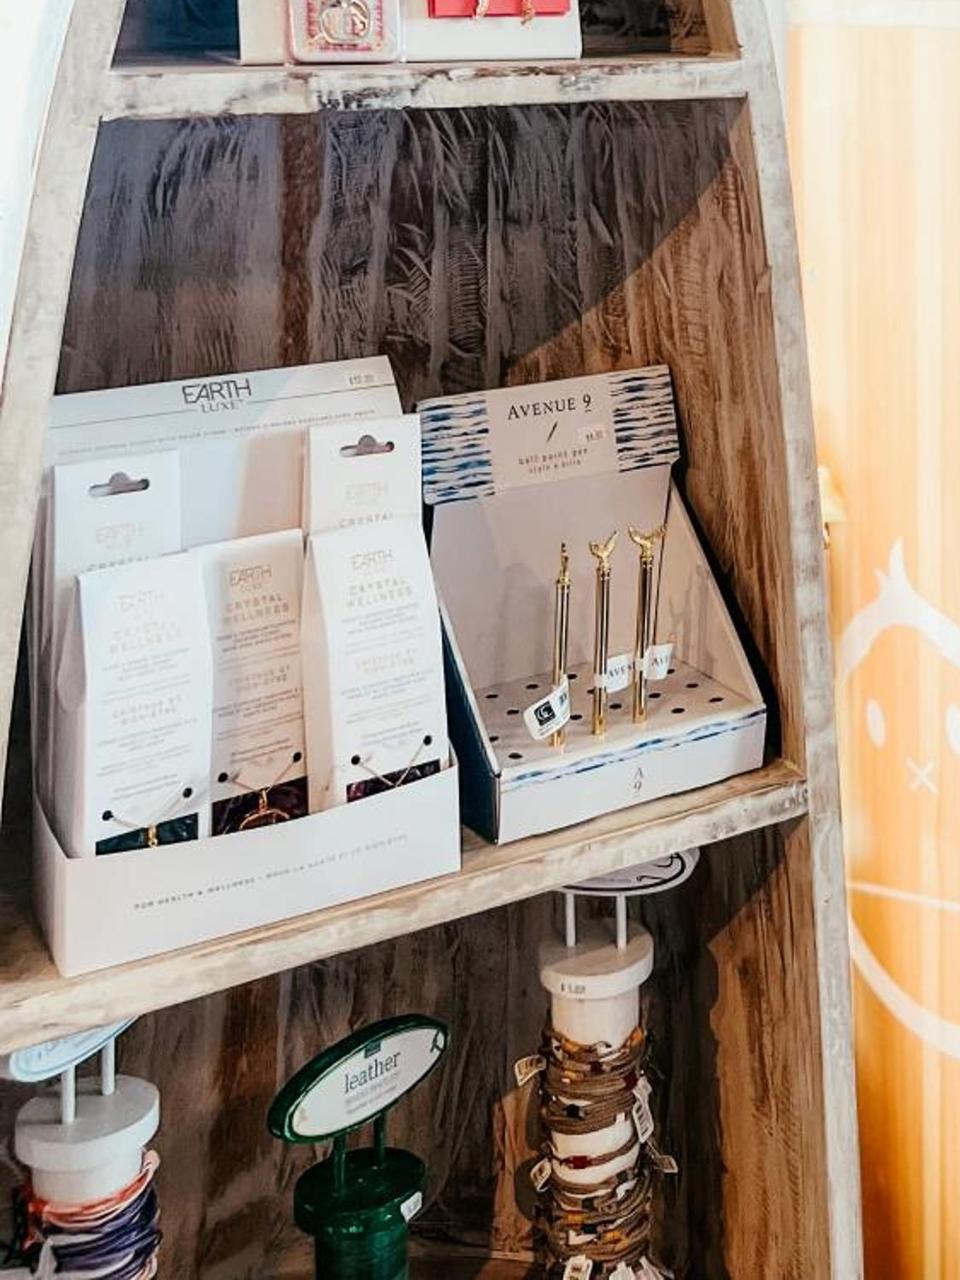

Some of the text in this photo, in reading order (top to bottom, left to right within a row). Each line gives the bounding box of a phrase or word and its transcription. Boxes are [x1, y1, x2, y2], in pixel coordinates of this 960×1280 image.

[181, 378, 252, 405] EARTH
[201, 399, 242, 414] LUXE
[508, 393, 592, 420] AVENUE 9
[345, 1052, 400, 1094] leather
